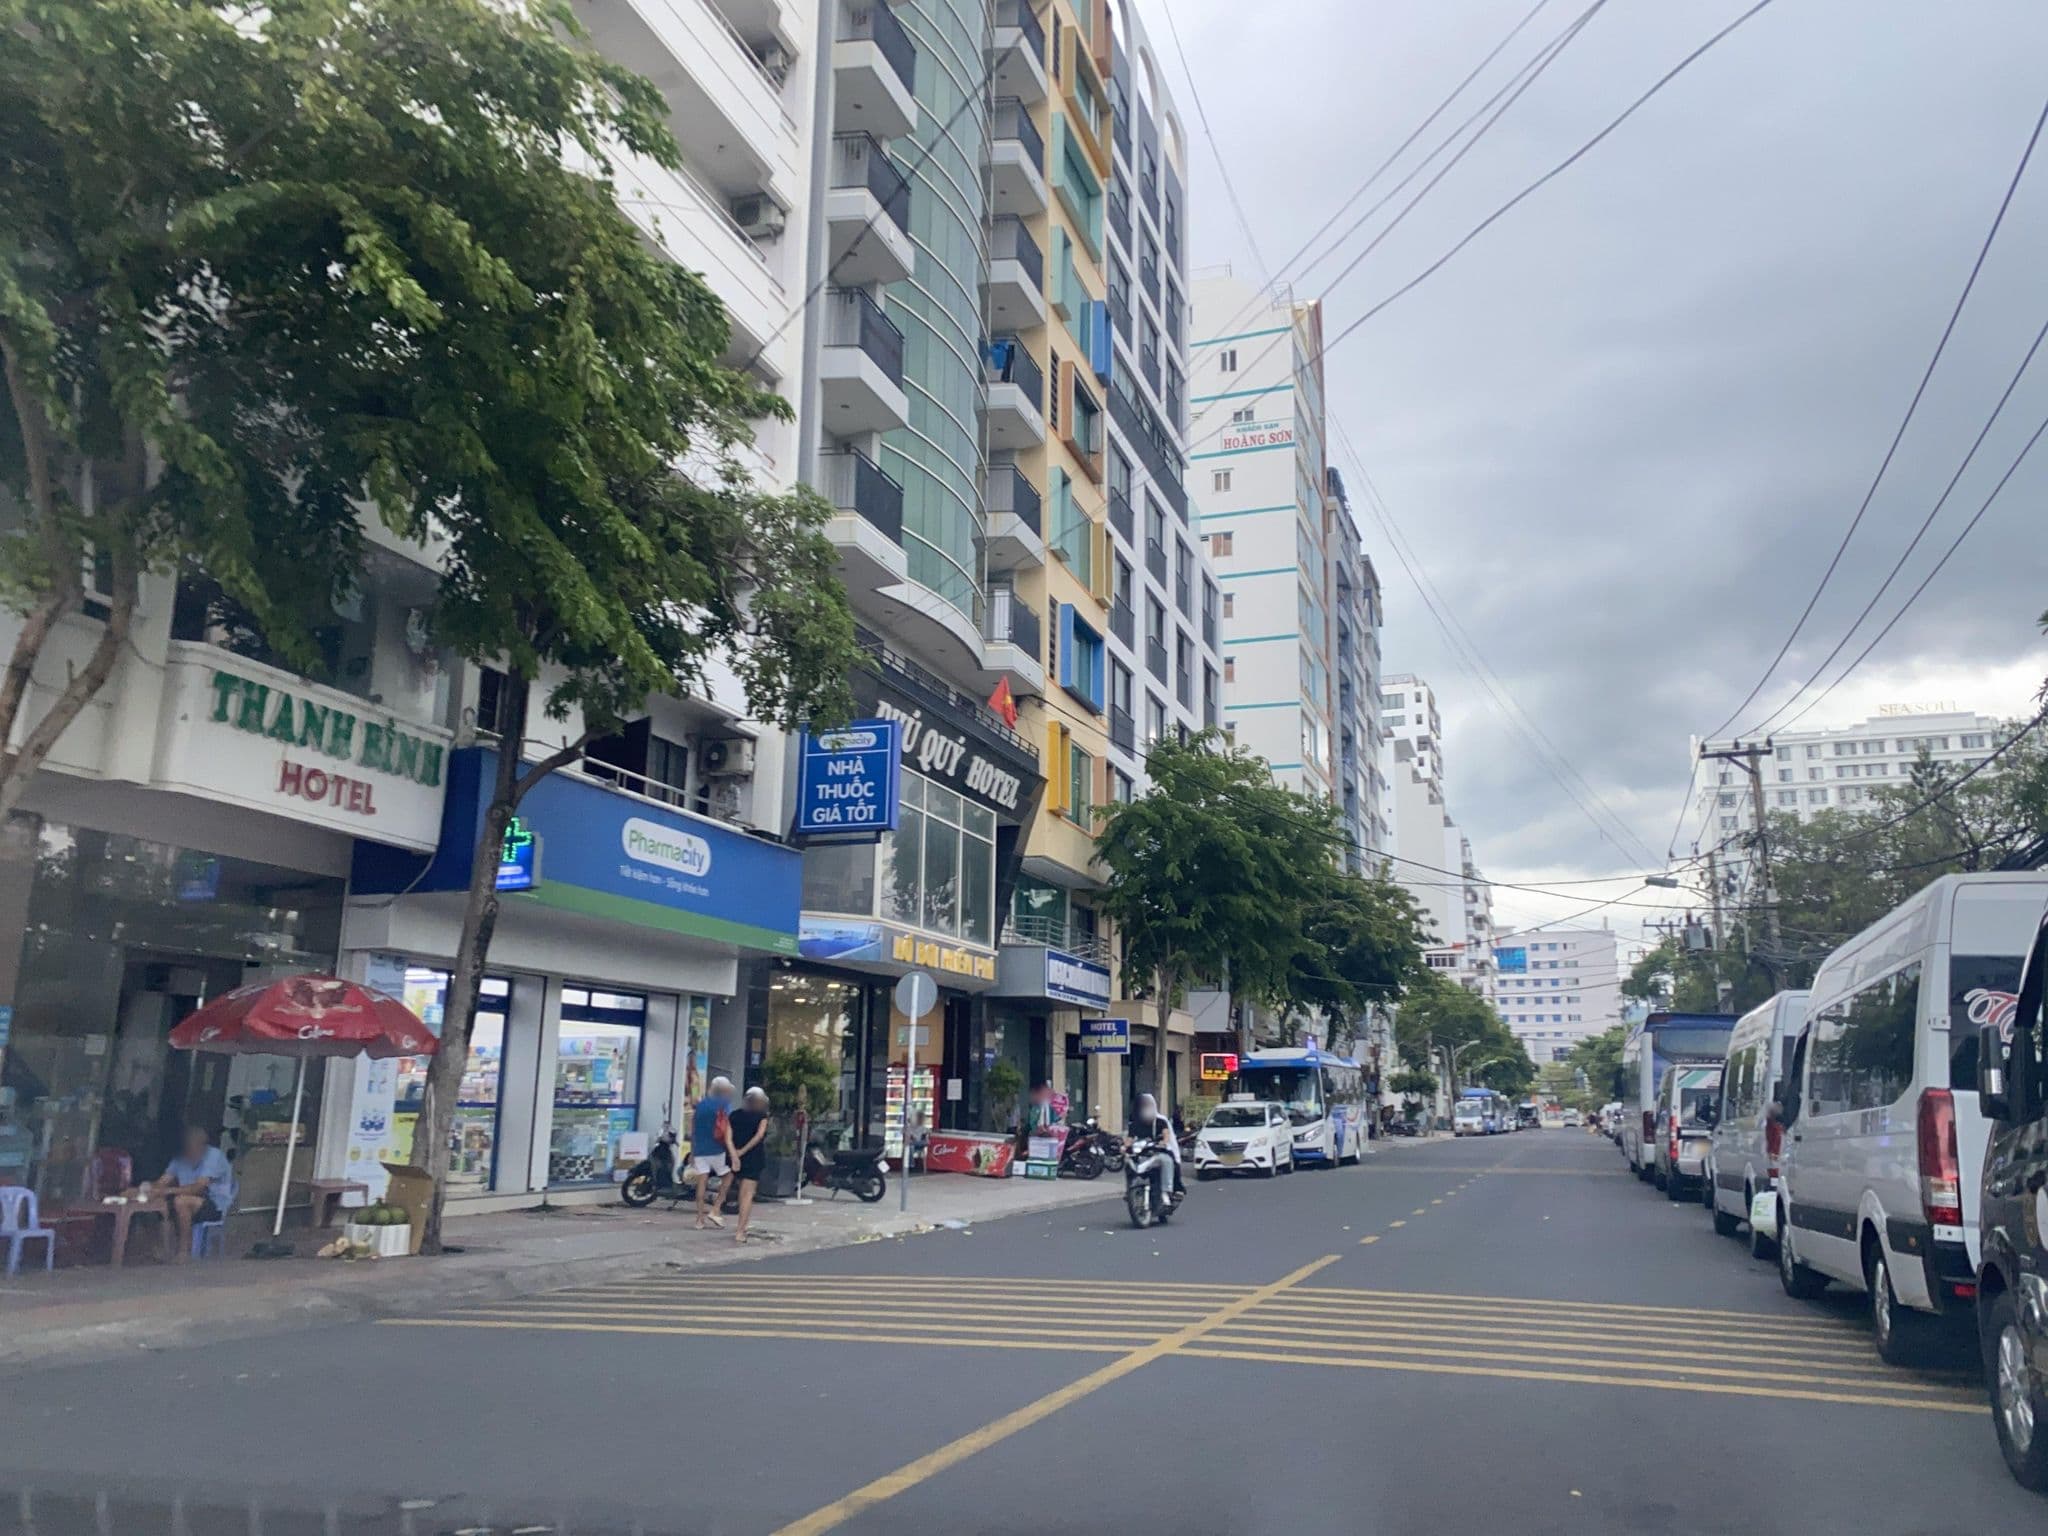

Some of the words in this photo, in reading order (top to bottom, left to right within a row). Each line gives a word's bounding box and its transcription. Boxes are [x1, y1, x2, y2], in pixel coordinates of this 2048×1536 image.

[1223, 433, 1265, 449] HOÀNG
[1268, 429, 1292, 444] SƠN
[213, 670, 356, 760] THANH
[359, 717, 443, 786] BÌNH
[827, 755, 866, 776] NHÀ
[279, 760, 376, 815] HOTEL
[816, 776, 875, 800] THUỐC
[965, 755, 1021, 810] HOTEL
[812, 803, 842, 823] GIÁ
[845, 798, 877, 822] TỐT
[628, 829, 705, 873] Pharmacity
[1090, 1022, 1118, 1032] HOTEL
